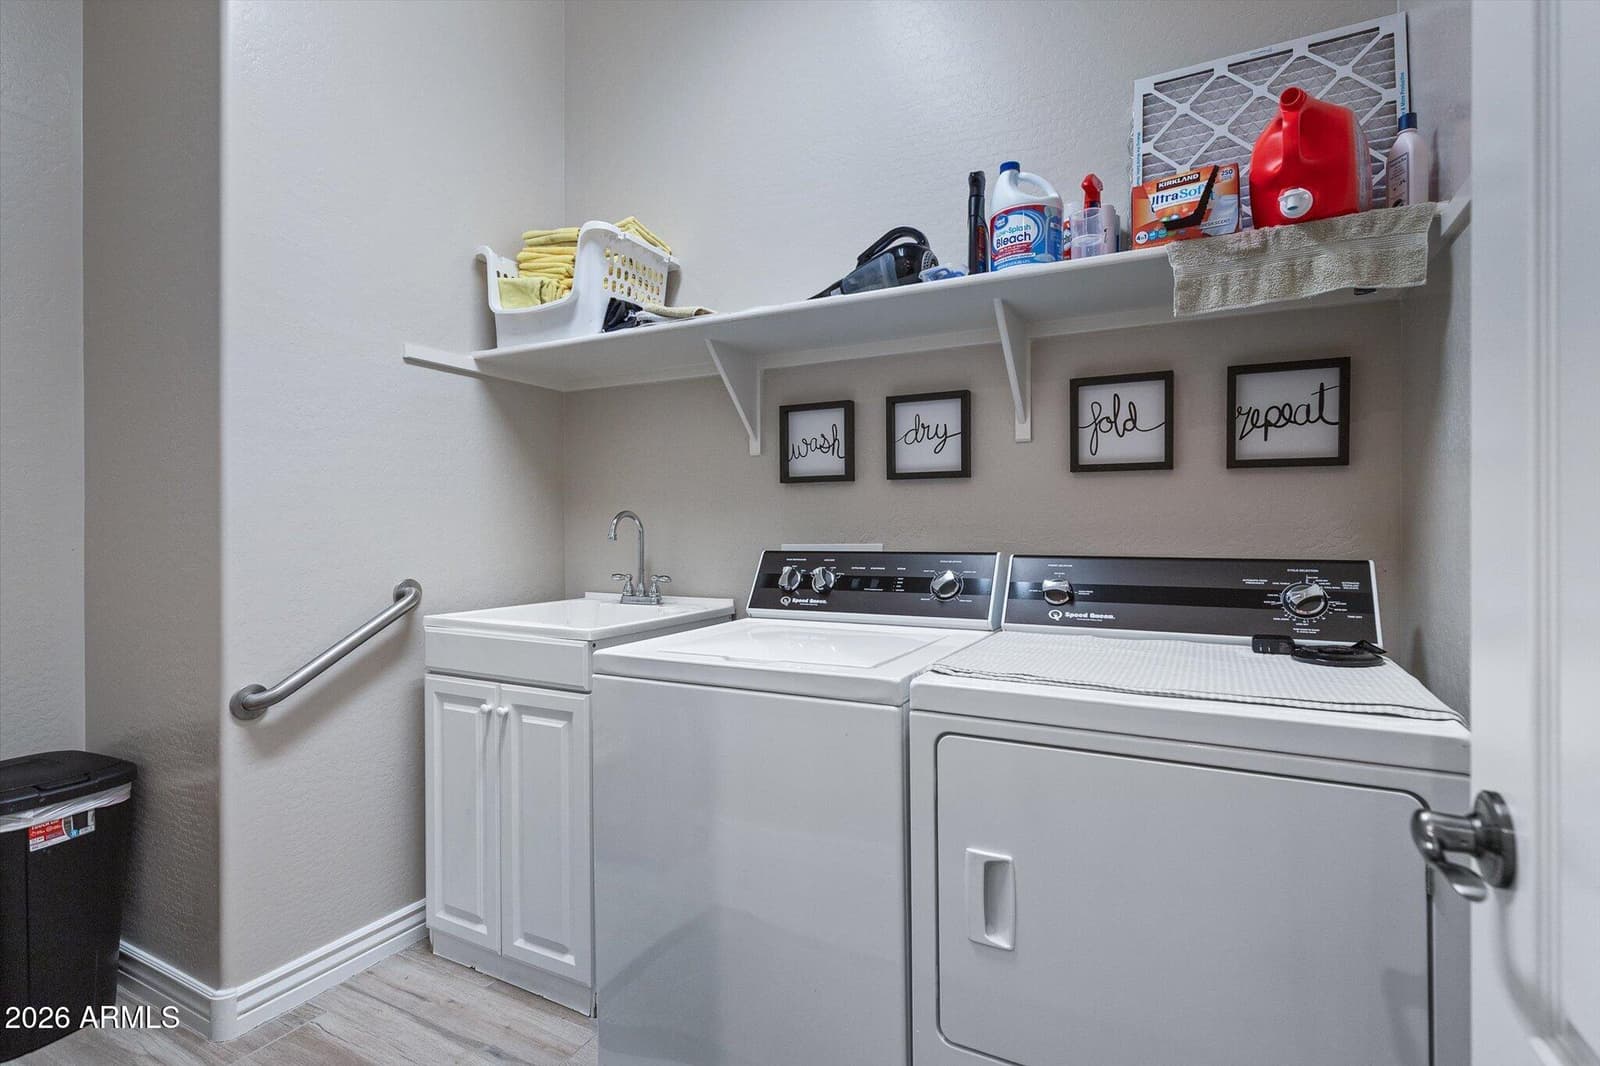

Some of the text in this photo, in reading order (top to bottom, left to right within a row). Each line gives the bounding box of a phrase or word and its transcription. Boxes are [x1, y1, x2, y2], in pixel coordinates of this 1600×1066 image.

[1151, 183, 1214, 206] ltraSof
[1158, 174, 1199, 188] KIRKLAND
[996, 231, 1031, 248] Bleach
[1079, 393, 1166, 456] fold
[1236, 382, 1341, 442] repeat
[788, 423, 846, 462] wash
[896, 413, 961, 454] dry
[1065, 611, 1088, 619] Speed
